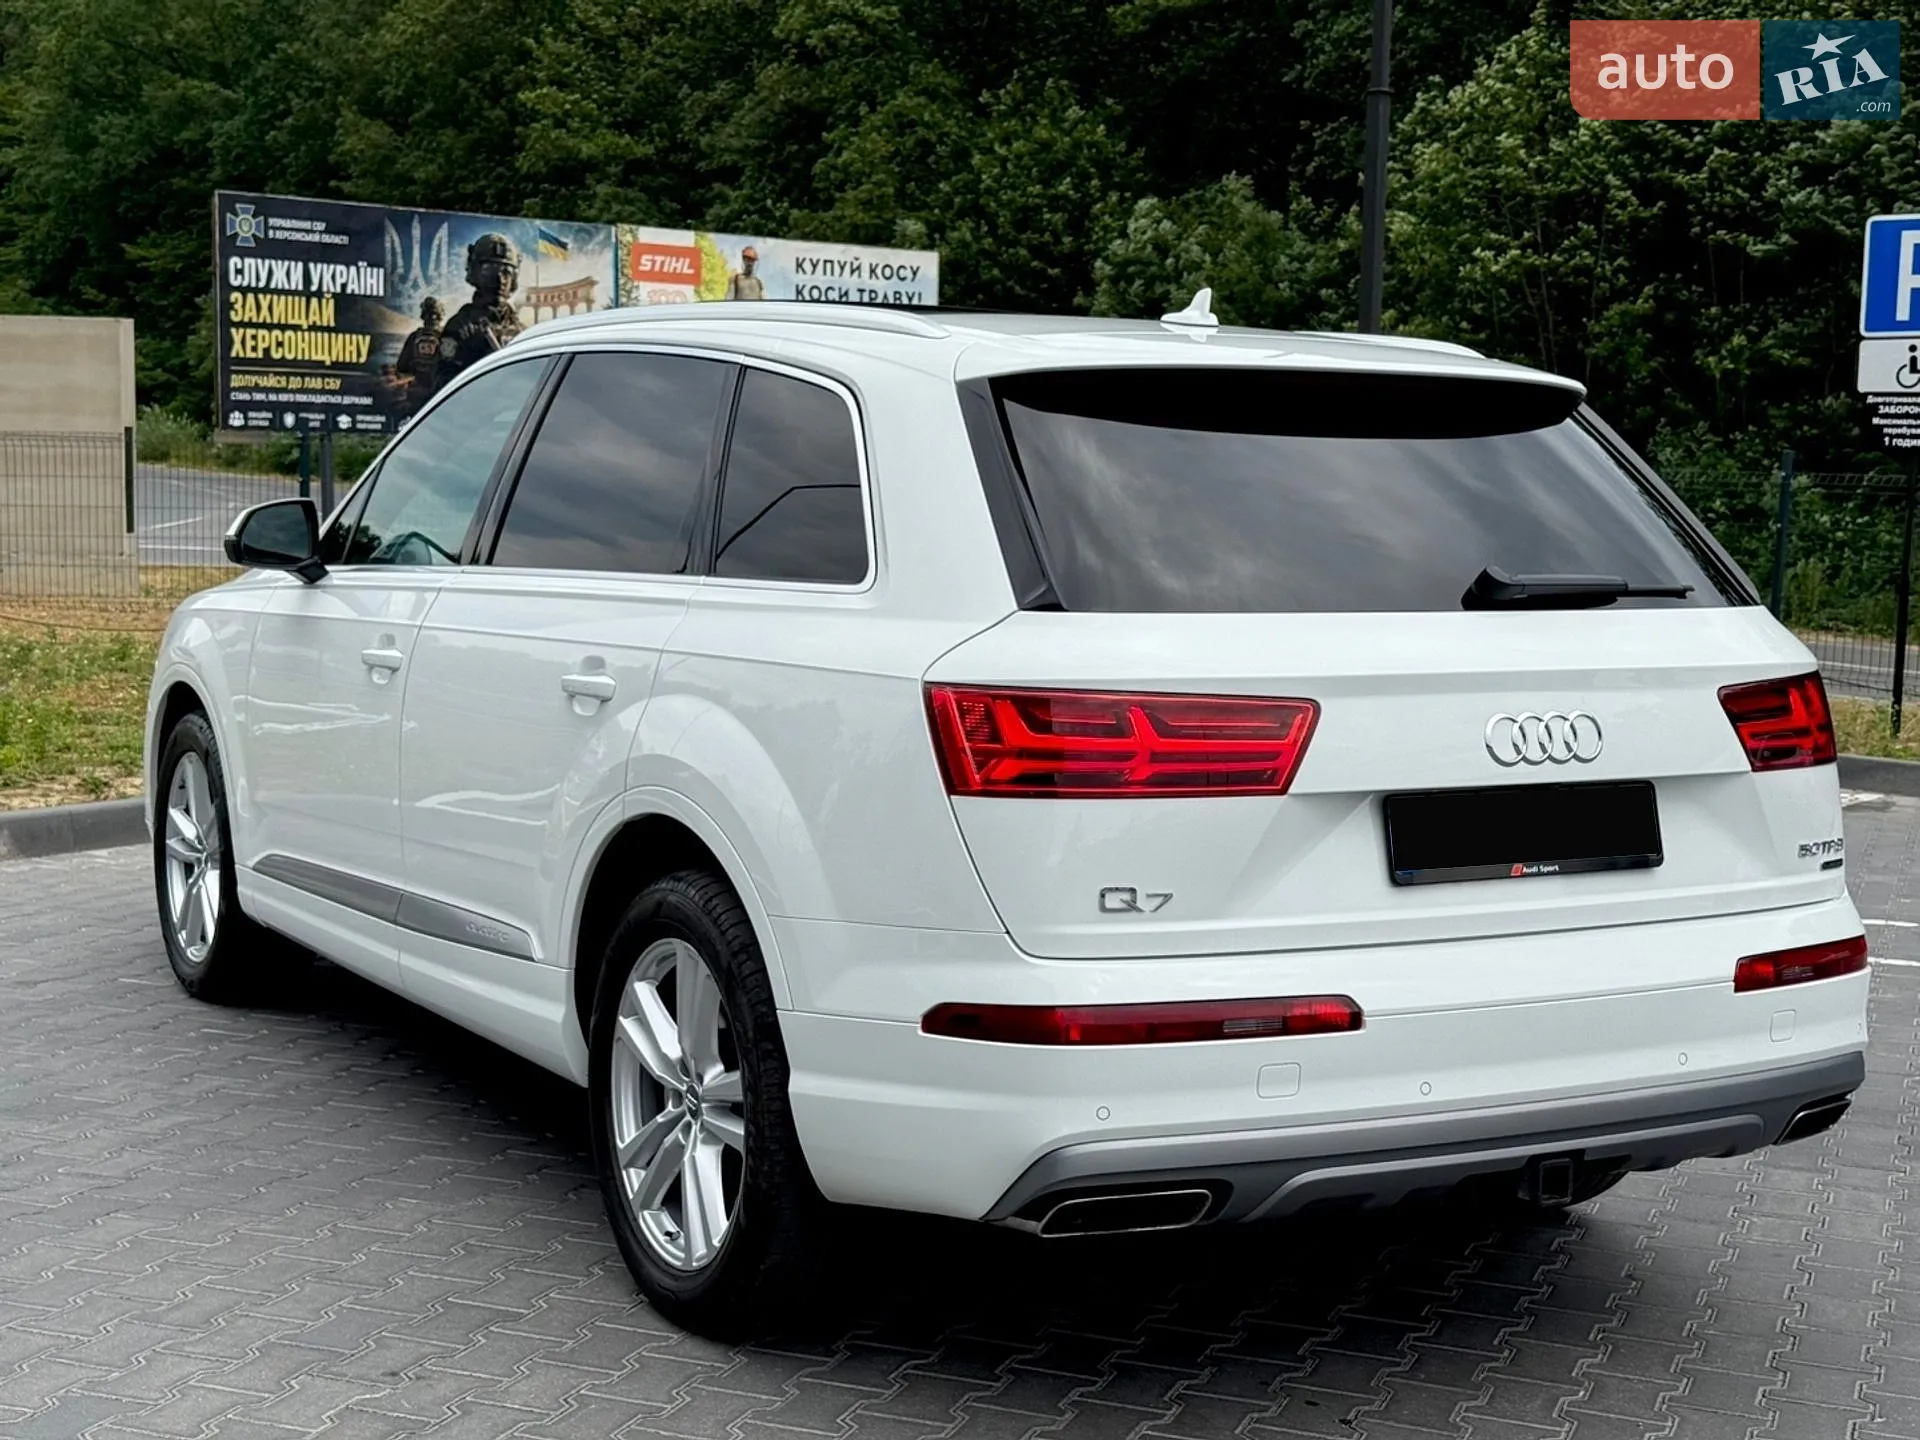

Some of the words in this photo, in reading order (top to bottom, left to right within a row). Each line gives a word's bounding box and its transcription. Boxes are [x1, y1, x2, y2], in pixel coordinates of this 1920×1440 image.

[228, 256, 304, 291] СЛУЖИ
[308, 260, 385, 297] УКРАЇНІ
[638, 254, 696, 274] STIHL
[795, 256, 862, 279] КУПУЙ
[869, 262, 921, 282] КОСУ
[795, 284, 850, 302] КОСИ
[856, 288, 923, 304] ТРАВУ!
[229, 291, 336, 329] ЗАХИЩАЙ
[230, 326, 371, 366] ХЕРСОНЩИНУ
[230, 373, 287, 389] ДОЛУЧАЙСЯ
[287, 377, 302, 390] ДО
[303, 377, 323, 389] ЛАВ
[324, 378, 341, 391] СБУ
[1883, 437, 1890, 446] 1
[1098, 886, 1174, 914] Q7
